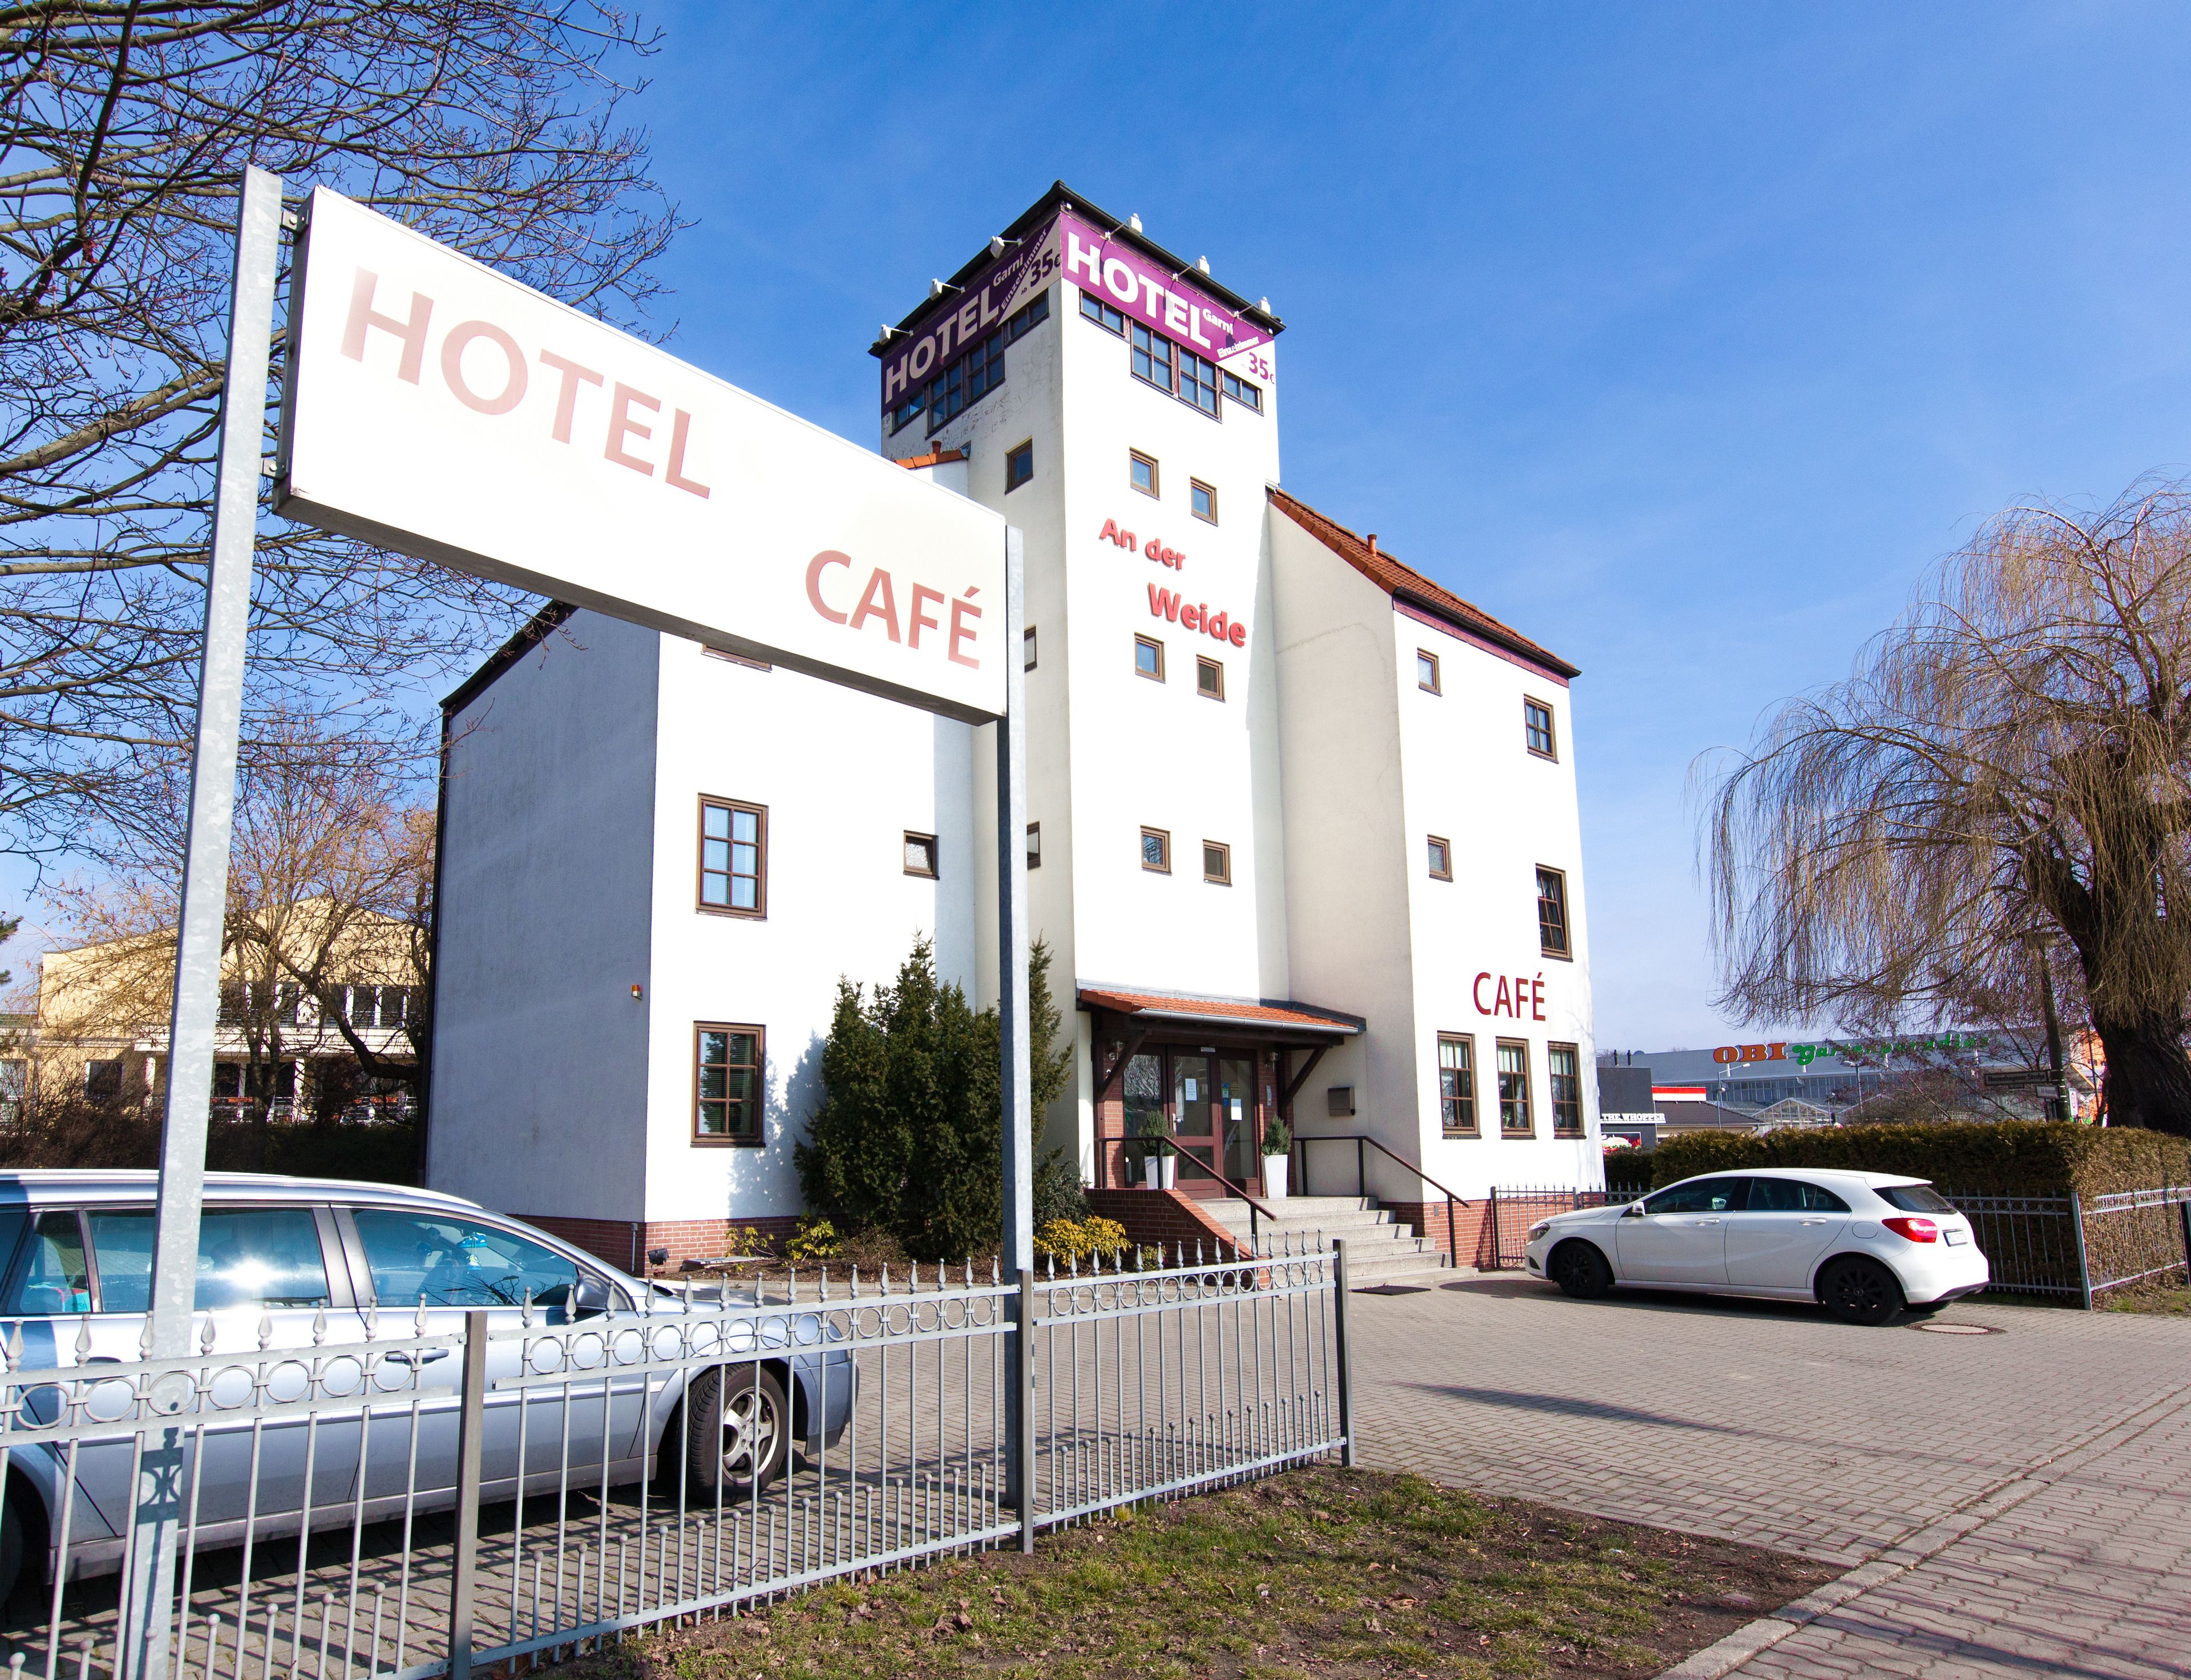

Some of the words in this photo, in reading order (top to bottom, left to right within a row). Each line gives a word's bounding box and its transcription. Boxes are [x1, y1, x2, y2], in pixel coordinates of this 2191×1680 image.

[993, 253, 1024, 286] Garni
[1001, 229, 1046, 310] Einzelzimmer
[1068, 231, 1211, 350] HOTEL
[886, 285, 999, 404] HOTEL
[1202, 308, 1234, 335] Garni
[339, 266, 711, 499] HOTEL
[1099, 518, 1137, 551] An
[1145, 538, 1186, 570] der
[806, 549, 983, 670] CAFÉ
[1148, 582, 1246, 646] Weide
[1473, 972, 1546, 1021] CAFÉ
[1713, 1042, 1788, 1064] OBI
